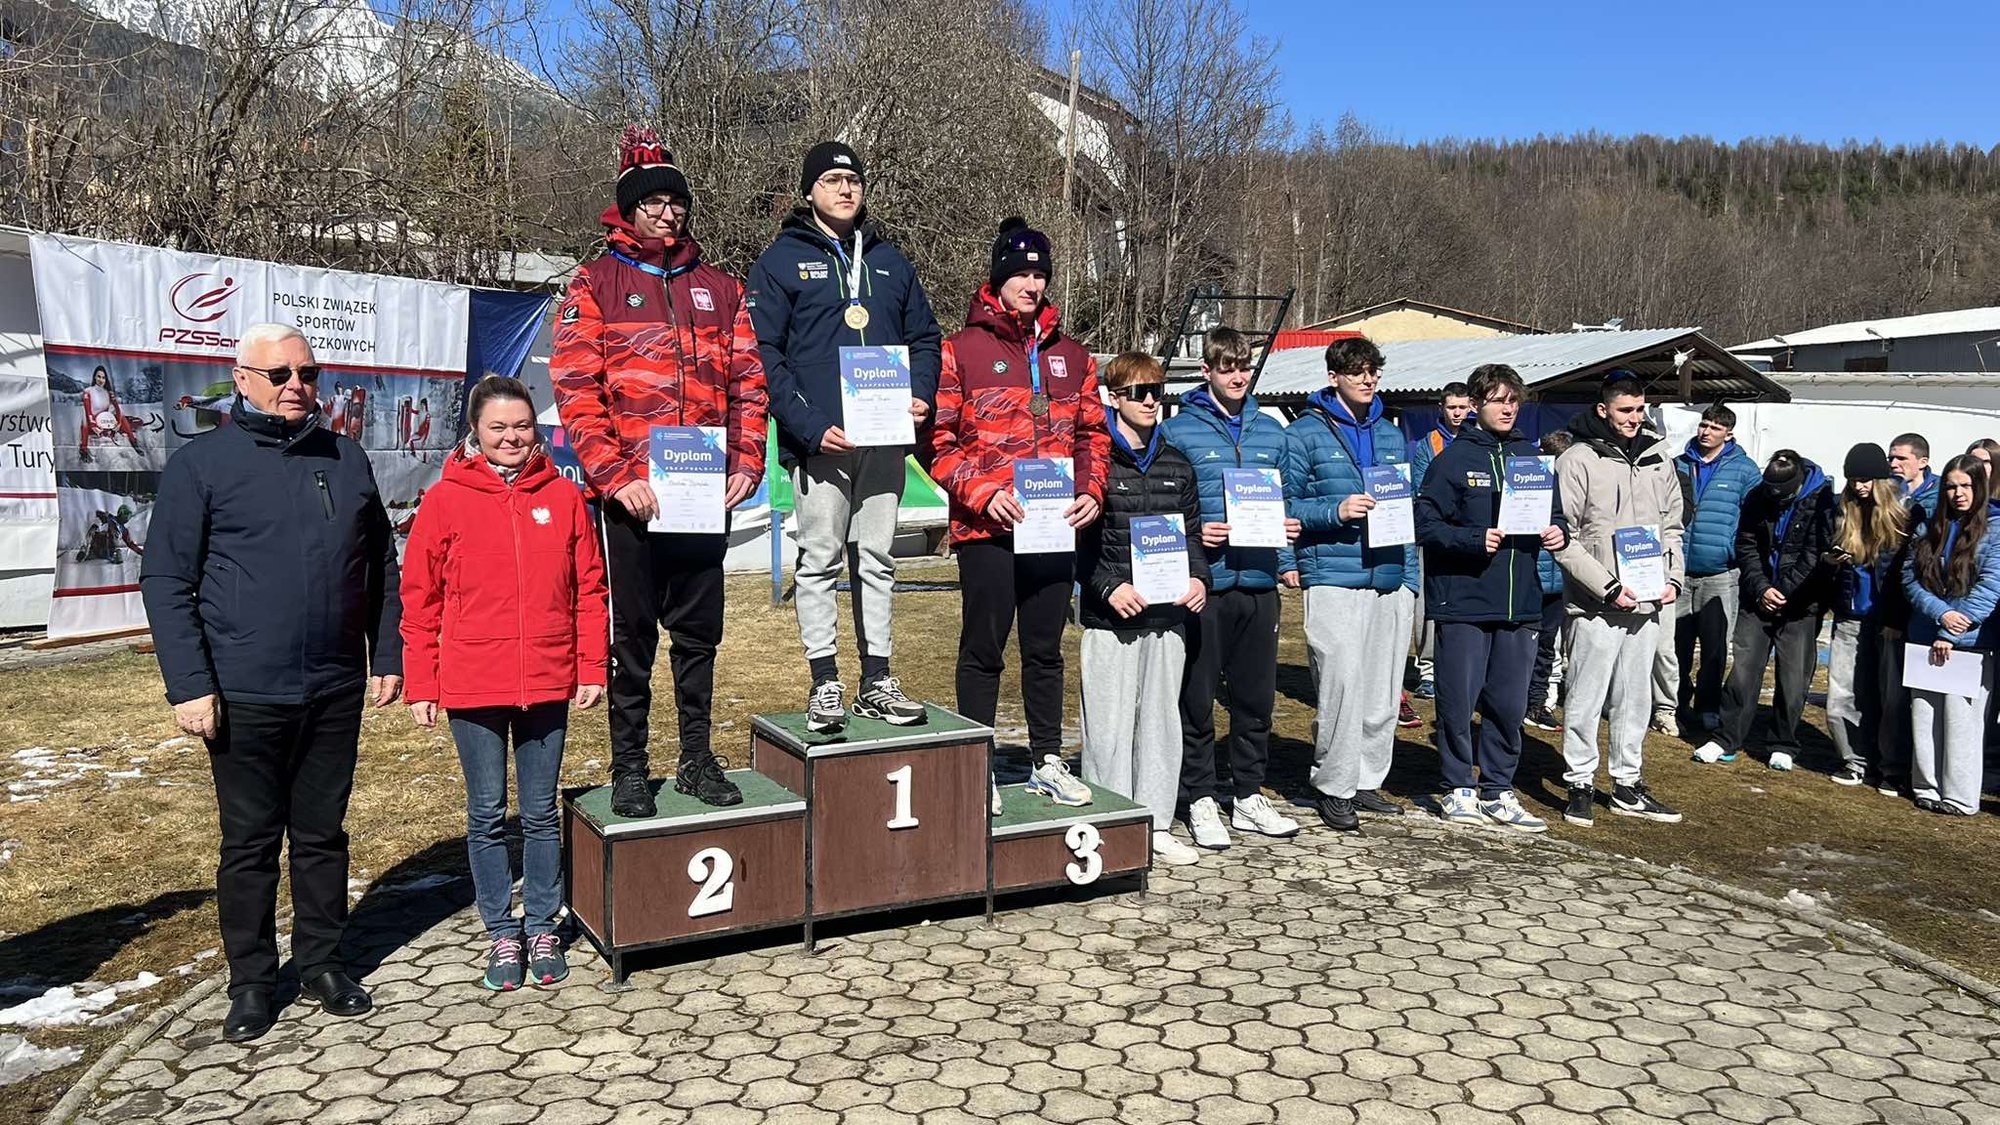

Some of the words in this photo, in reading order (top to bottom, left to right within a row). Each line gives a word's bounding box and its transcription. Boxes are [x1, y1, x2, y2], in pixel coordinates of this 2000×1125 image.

[273, 293, 319, 309] POLSKI
[323, 298, 377, 315] ZWIĄZEK
[296, 316, 356, 331] SPORTÓW
[307, 335, 376, 352] CZKOWYCH
[854, 367, 897, 381] Dyplom
[663, 449, 712, 463] Dyplom
[1025, 479, 1063, 491] Dyplom
[1514, 473, 1545, 483] Dyplom
[1235, 484, 1272, 494] Dyplom
[1374, 483, 1404, 494] Dyplom
[1141, 534, 1177, 546] Dyplom
[1624, 543, 1654, 553] Dyplom
[887, 764, 919, 829] 1
[1064, 823, 1103, 885] 3
[687, 847, 733, 917] 2
